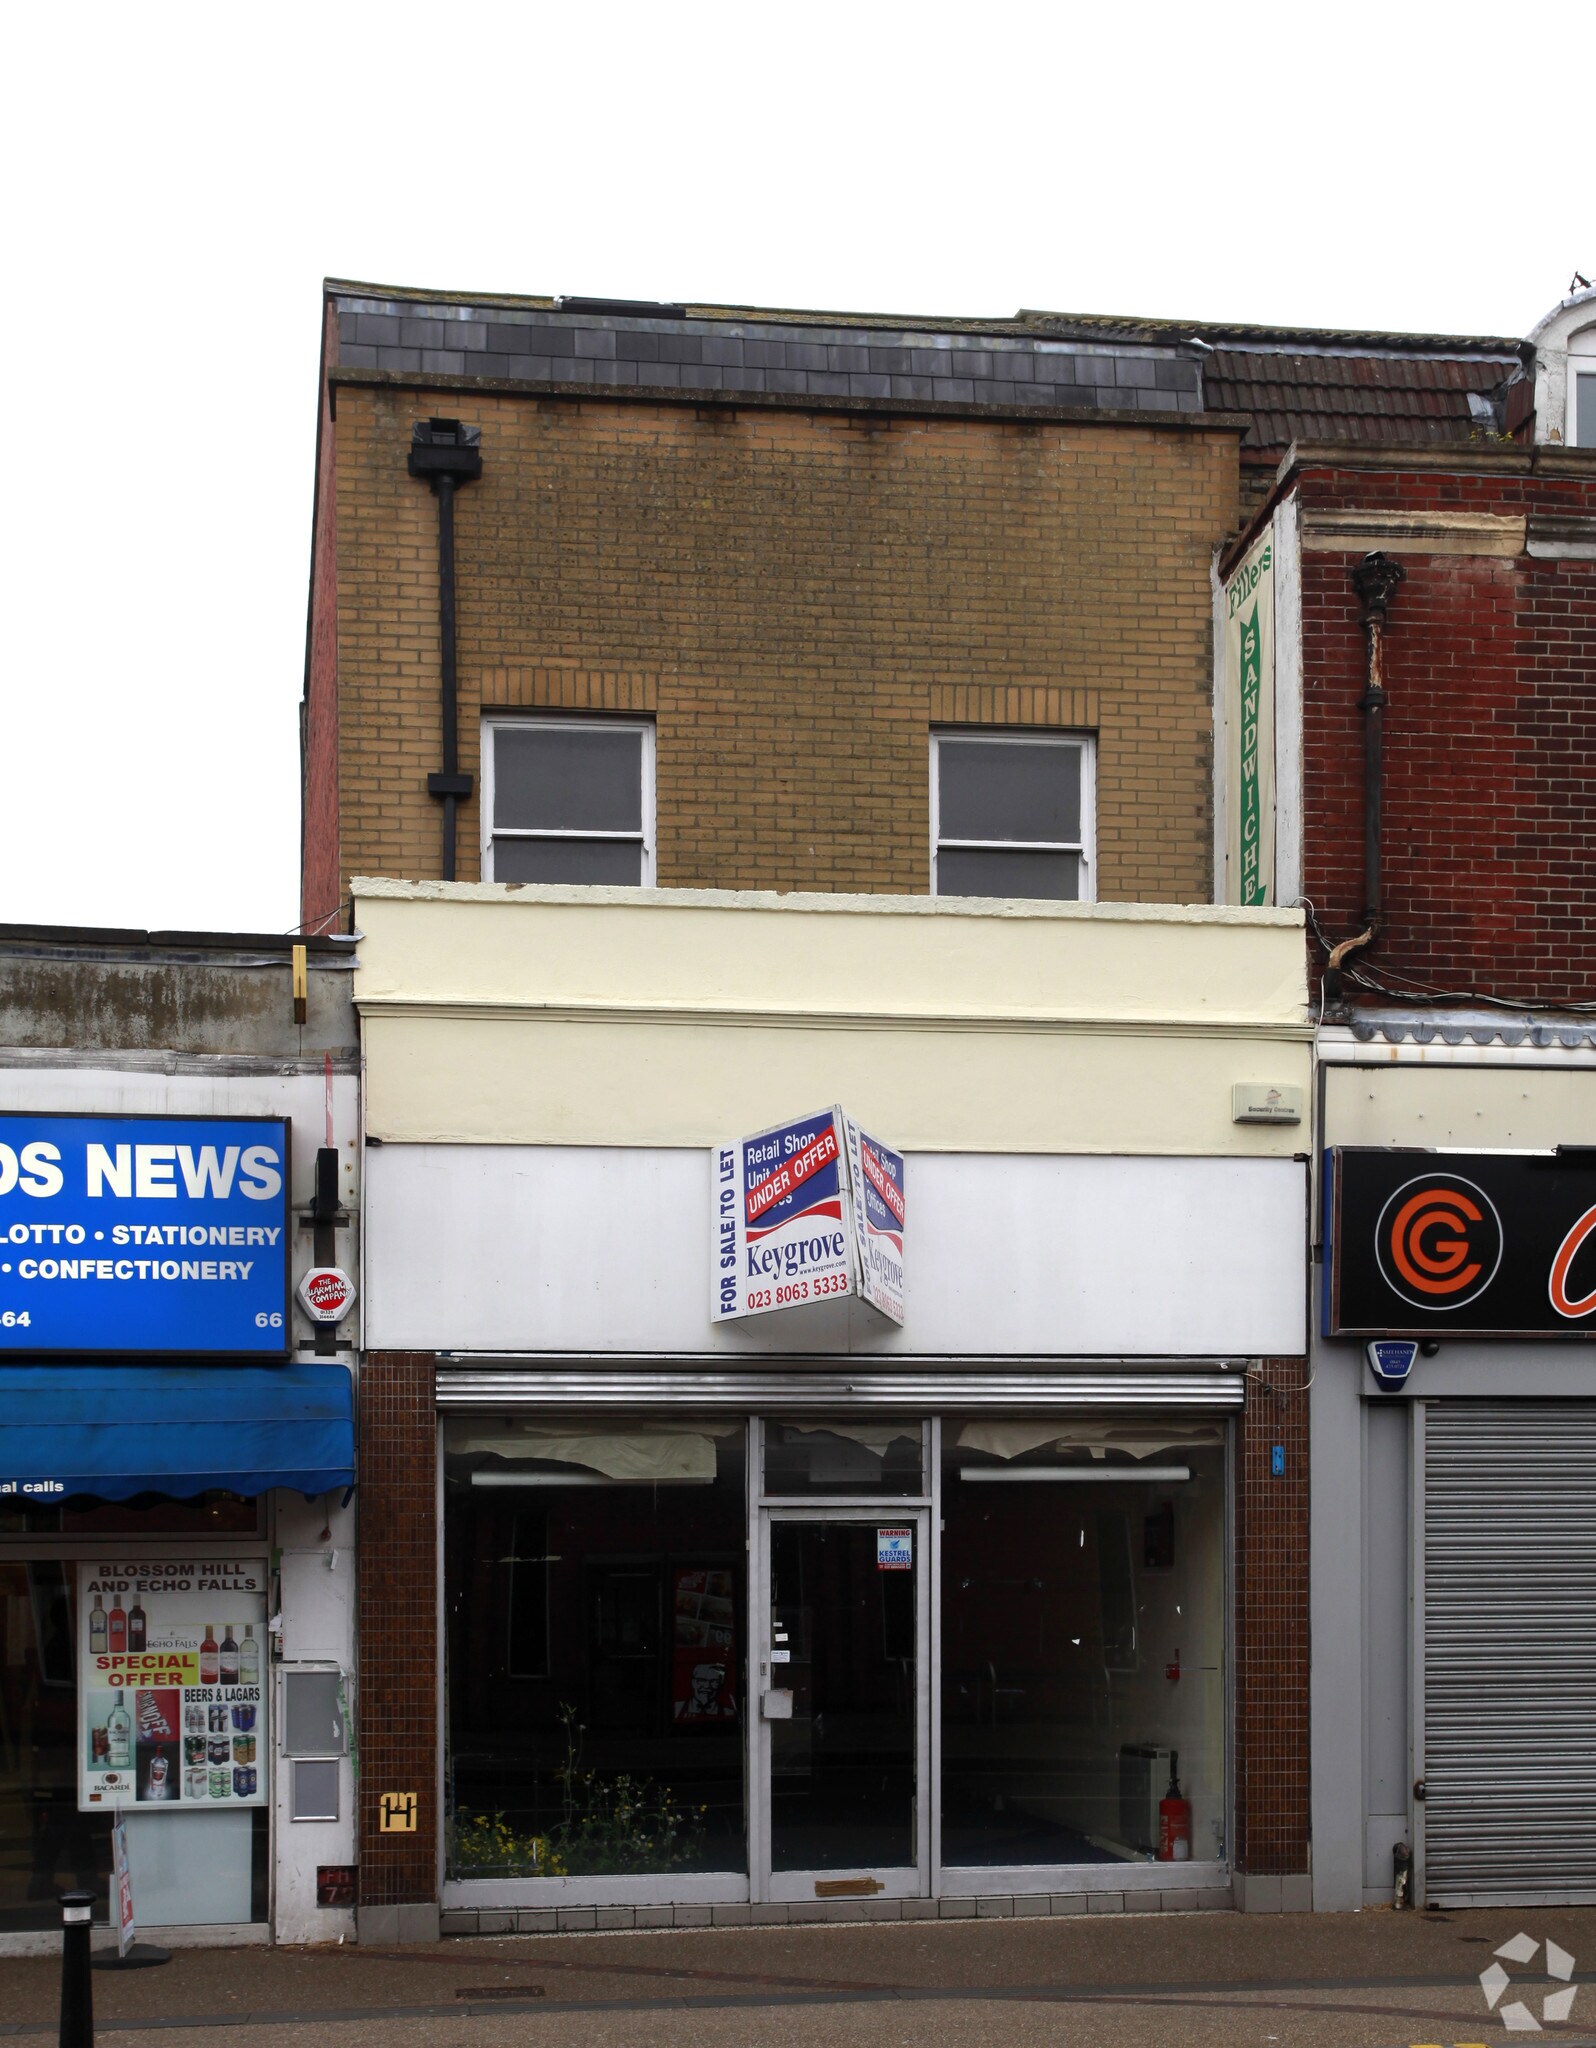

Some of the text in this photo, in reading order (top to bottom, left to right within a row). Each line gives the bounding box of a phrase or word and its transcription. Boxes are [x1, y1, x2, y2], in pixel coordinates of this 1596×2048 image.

[1229, 545, 1271, 620] Fillers
[747, 1139, 780, 1166] Retail
[0, 1141, 282, 1201] S NEWS
[749, 1170, 790, 1214] UNDER
[794, 1135, 835, 1178] OFFER
[863, 1149, 884, 1192] UNDER
[885, 1182, 904, 1218] OFFER
[112, 1225, 282, 1246] STATIONERY
[719, 1150, 737, 1314] FOR SALE/TO LET
[746, 1231, 845, 1280] Keygrove
[868, 1237, 903, 1289] Keygrove
[18, 1258, 254, 1281] CONFECTIONERY
[800, 1260, 847, 1275] www.keygrove.com
[305, 1281, 346, 1298] ALARMING
[318, 1278, 331, 1286] THE
[747, 1273, 848, 1310] 023 8063 5333
[311, 1287, 352, 1304] COMPANY
[0, 1310, 283, 1328] 64 66
[0, 1480, 64, 1493] al calls
[99, 1563, 246, 1577] BLOSSOM HILL
[87, 1578, 257, 1593] AND ECHO FALLS
[147, 1639, 198, 1649] ECHO FALLS
[96, 1655, 195, 1670] SPECIAL
[108, 1672, 183, 1687] OFFER
[184, 1687, 260, 1702] BEERS & LAGARS
[385, 1797, 412, 1828] H
